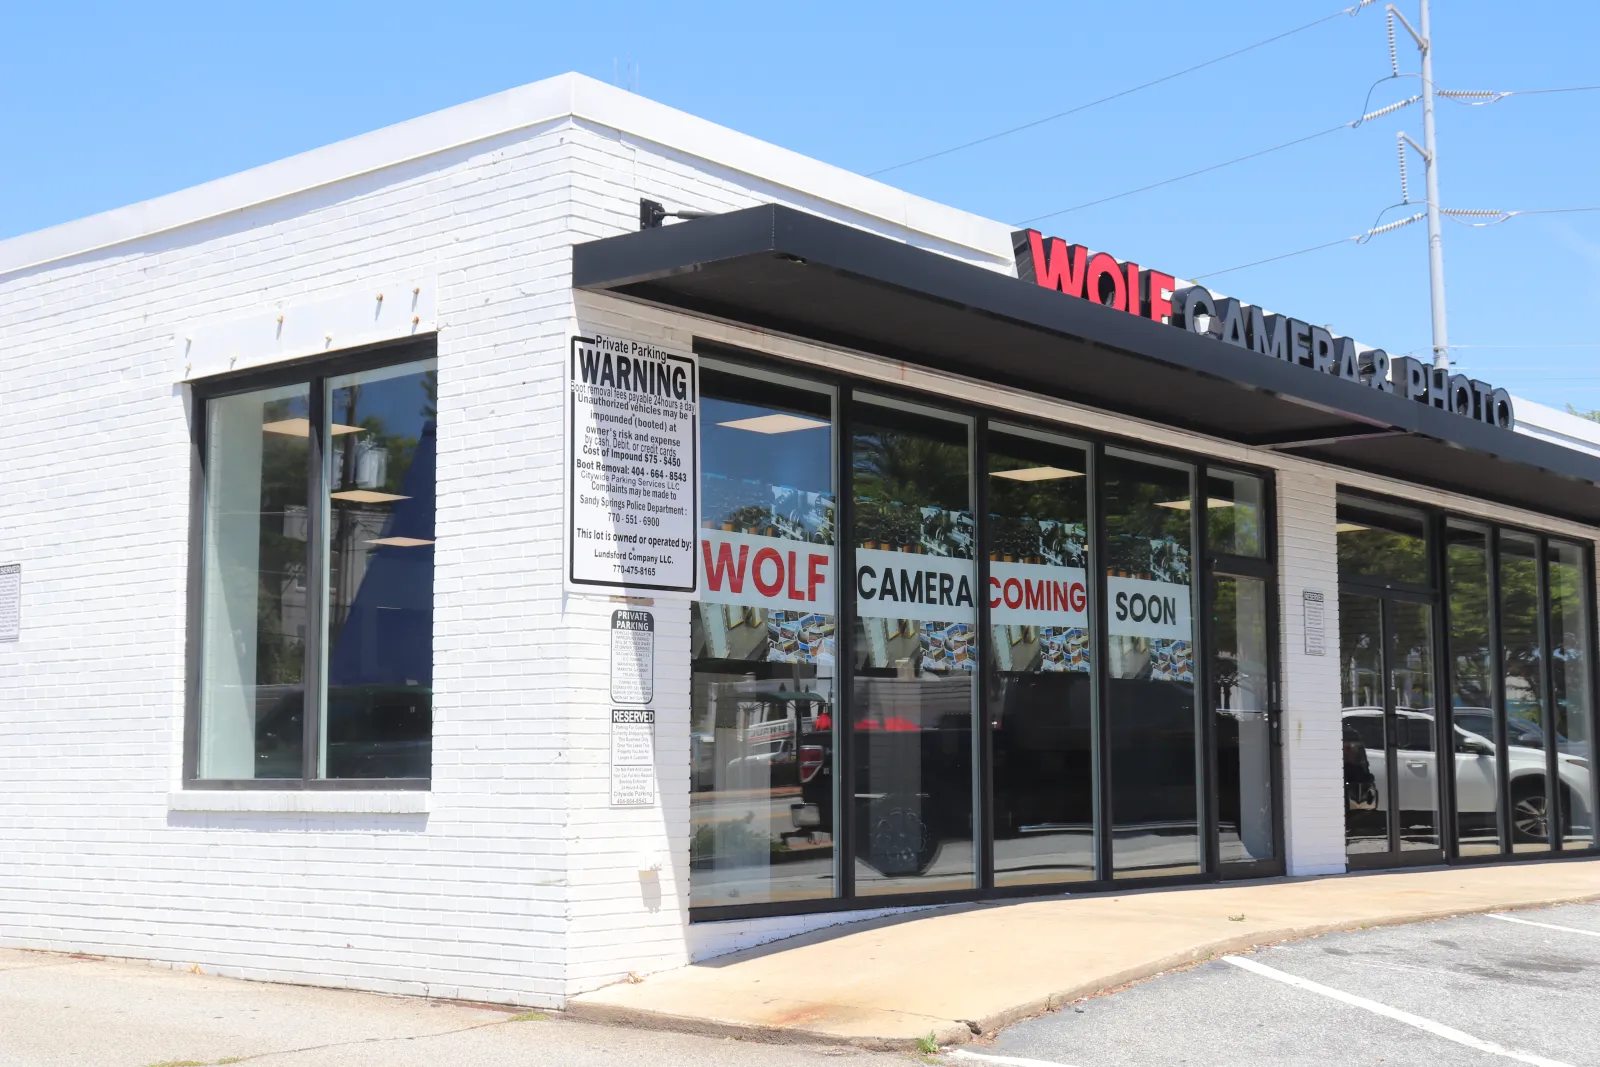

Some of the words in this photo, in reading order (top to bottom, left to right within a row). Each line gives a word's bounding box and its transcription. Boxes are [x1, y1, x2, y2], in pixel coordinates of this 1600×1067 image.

[1014, 228, 1175, 325] WOLF
[1176, 285, 1361, 385] CAMERA
[1362, 349, 1395, 393] &
[1396, 356, 1515, 432] PHOTO
[596, 335, 628, 354] Private
[632, 342, 666, 364] Parking
[578, 348, 686, 400] WARNING
[570, 381, 586, 392] Boot
[588, 384, 612, 397] removal
[628, 392, 652, 406] payable
[578, 394, 629, 410] Unauthorized
[630, 402, 660, 415] vehicles
[662, 408, 678, 420] may
[680, 410, 688, 419] be
[590, 410, 632, 425] impounded
[634, 416, 667, 431] (booted)
[669, 423, 676, 432] at
[584, 434, 592, 446] by
[632, 443, 639, 451] or
[640, 443, 658, 454] credit
[660, 446, 677, 458] cards
[586, 426, 616, 437] owner's
[618, 429, 632, 439] risk
[634, 433, 649, 442] and
[650, 436, 680, 447] expense
[583, 445, 600, 455] Cost
[602, 448, 610, 457] of
[611, 450, 642, 462] Impound
[644, 454, 657, 464] $75
[663, 456, 681, 467] $450
[576, 458, 594, 470] Boot
[596, 461, 630, 474] Removal:
[631, 466, 644, 476] 404
[650, 468, 663, 479] 664
[670, 471, 687, 482] 8543
[581, 470, 609, 482] Citywide
[611, 474, 636, 487] Parking
[638, 478, 665, 489] Services
[667, 482, 680, 490] LLC
[592, 480, 627, 494] Complaints
[629, 486, 641, 498] may
[652, 490, 669, 499] made
[670, 492, 676, 500] to
[580, 494, 599, 508] Sandy
[601, 497, 625, 510] Springs
[626, 500, 646, 511] Police
[608, 512, 620, 522] 770
[626, 514, 637, 524] 551
[643, 516, 660, 527] 6900
[577, 528, 592, 538] This
[594, 530, 603, 540] lot
[605, 530, 611, 540] is
[613, 534, 637, 543] owned
[648, 537, 680, 548] operated
[681, 539, 692, 551] by:
[594, 550, 626, 560] Lundsford
[629, 552, 658, 565] Company
[660, 555, 674, 564] LLC.
[613, 565, 655, 576] 770-475-8165
[701, 540, 828, 602] WOLF
[857, 565, 974, 607] CAMERA
[990, 576, 1086, 612] COMING
[1116, 591, 1176, 626] SOON
[617, 620, 648, 630] PARKING
[618, 611, 647, 621] PRIVATE
[614, 711, 654, 722] RESERVED
